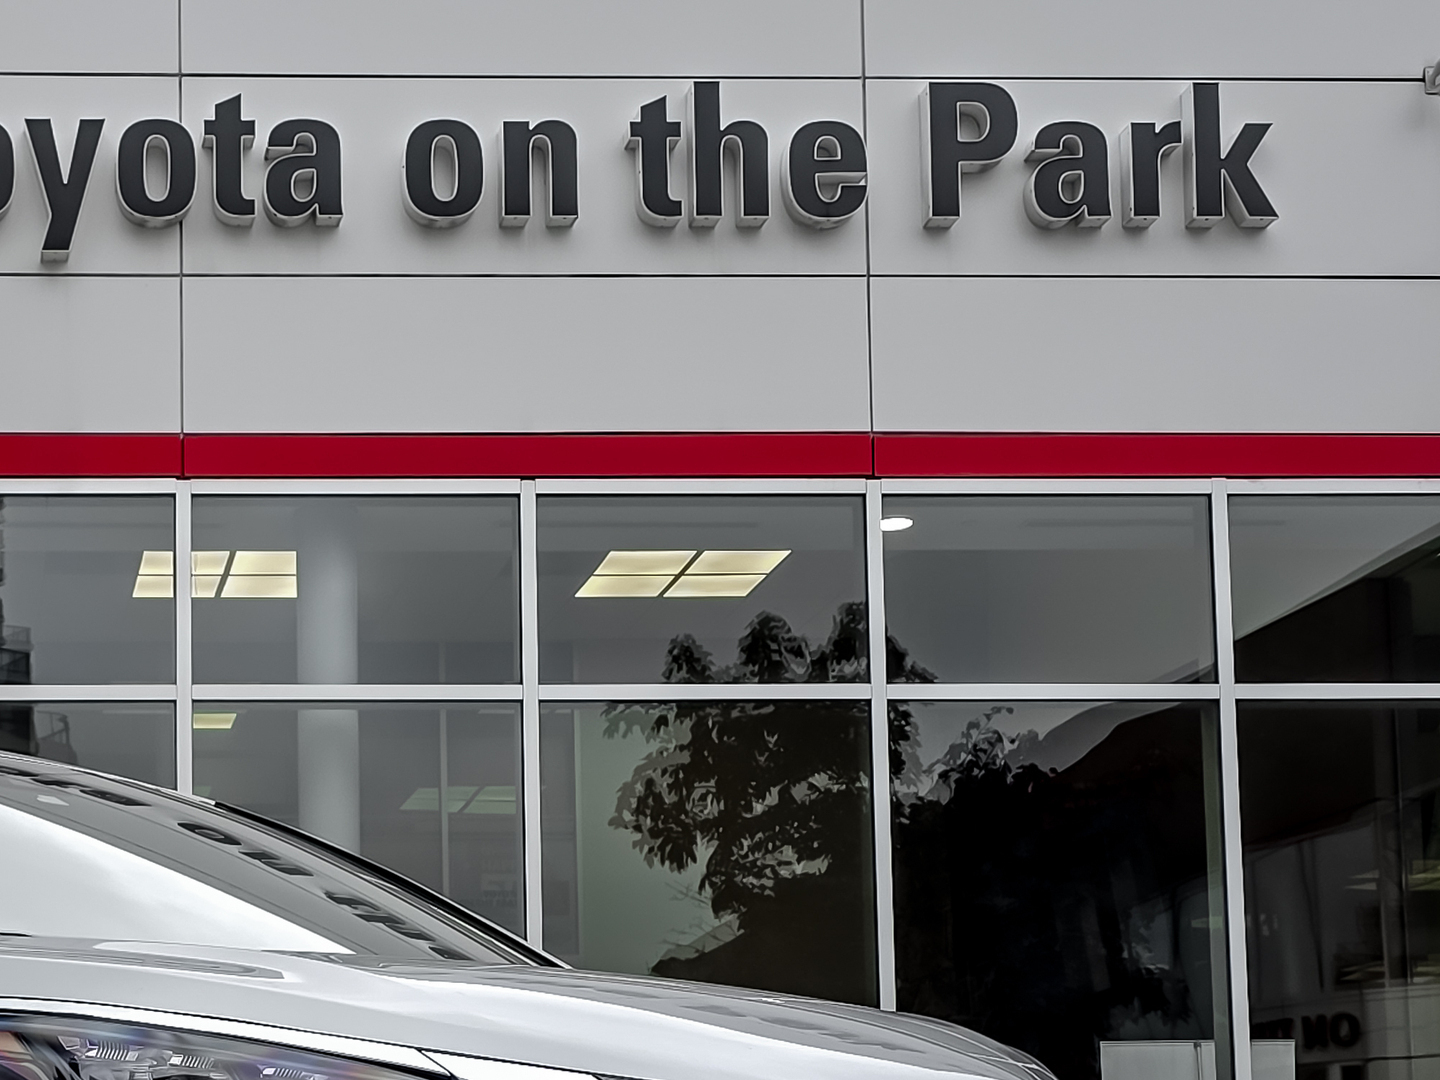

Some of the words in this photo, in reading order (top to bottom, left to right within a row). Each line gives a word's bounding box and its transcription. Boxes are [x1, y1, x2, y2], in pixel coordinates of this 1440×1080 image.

[402, 118, 579, 230] on
[623, 80, 868, 229] the
[917, 80, 1279, 230] Park
